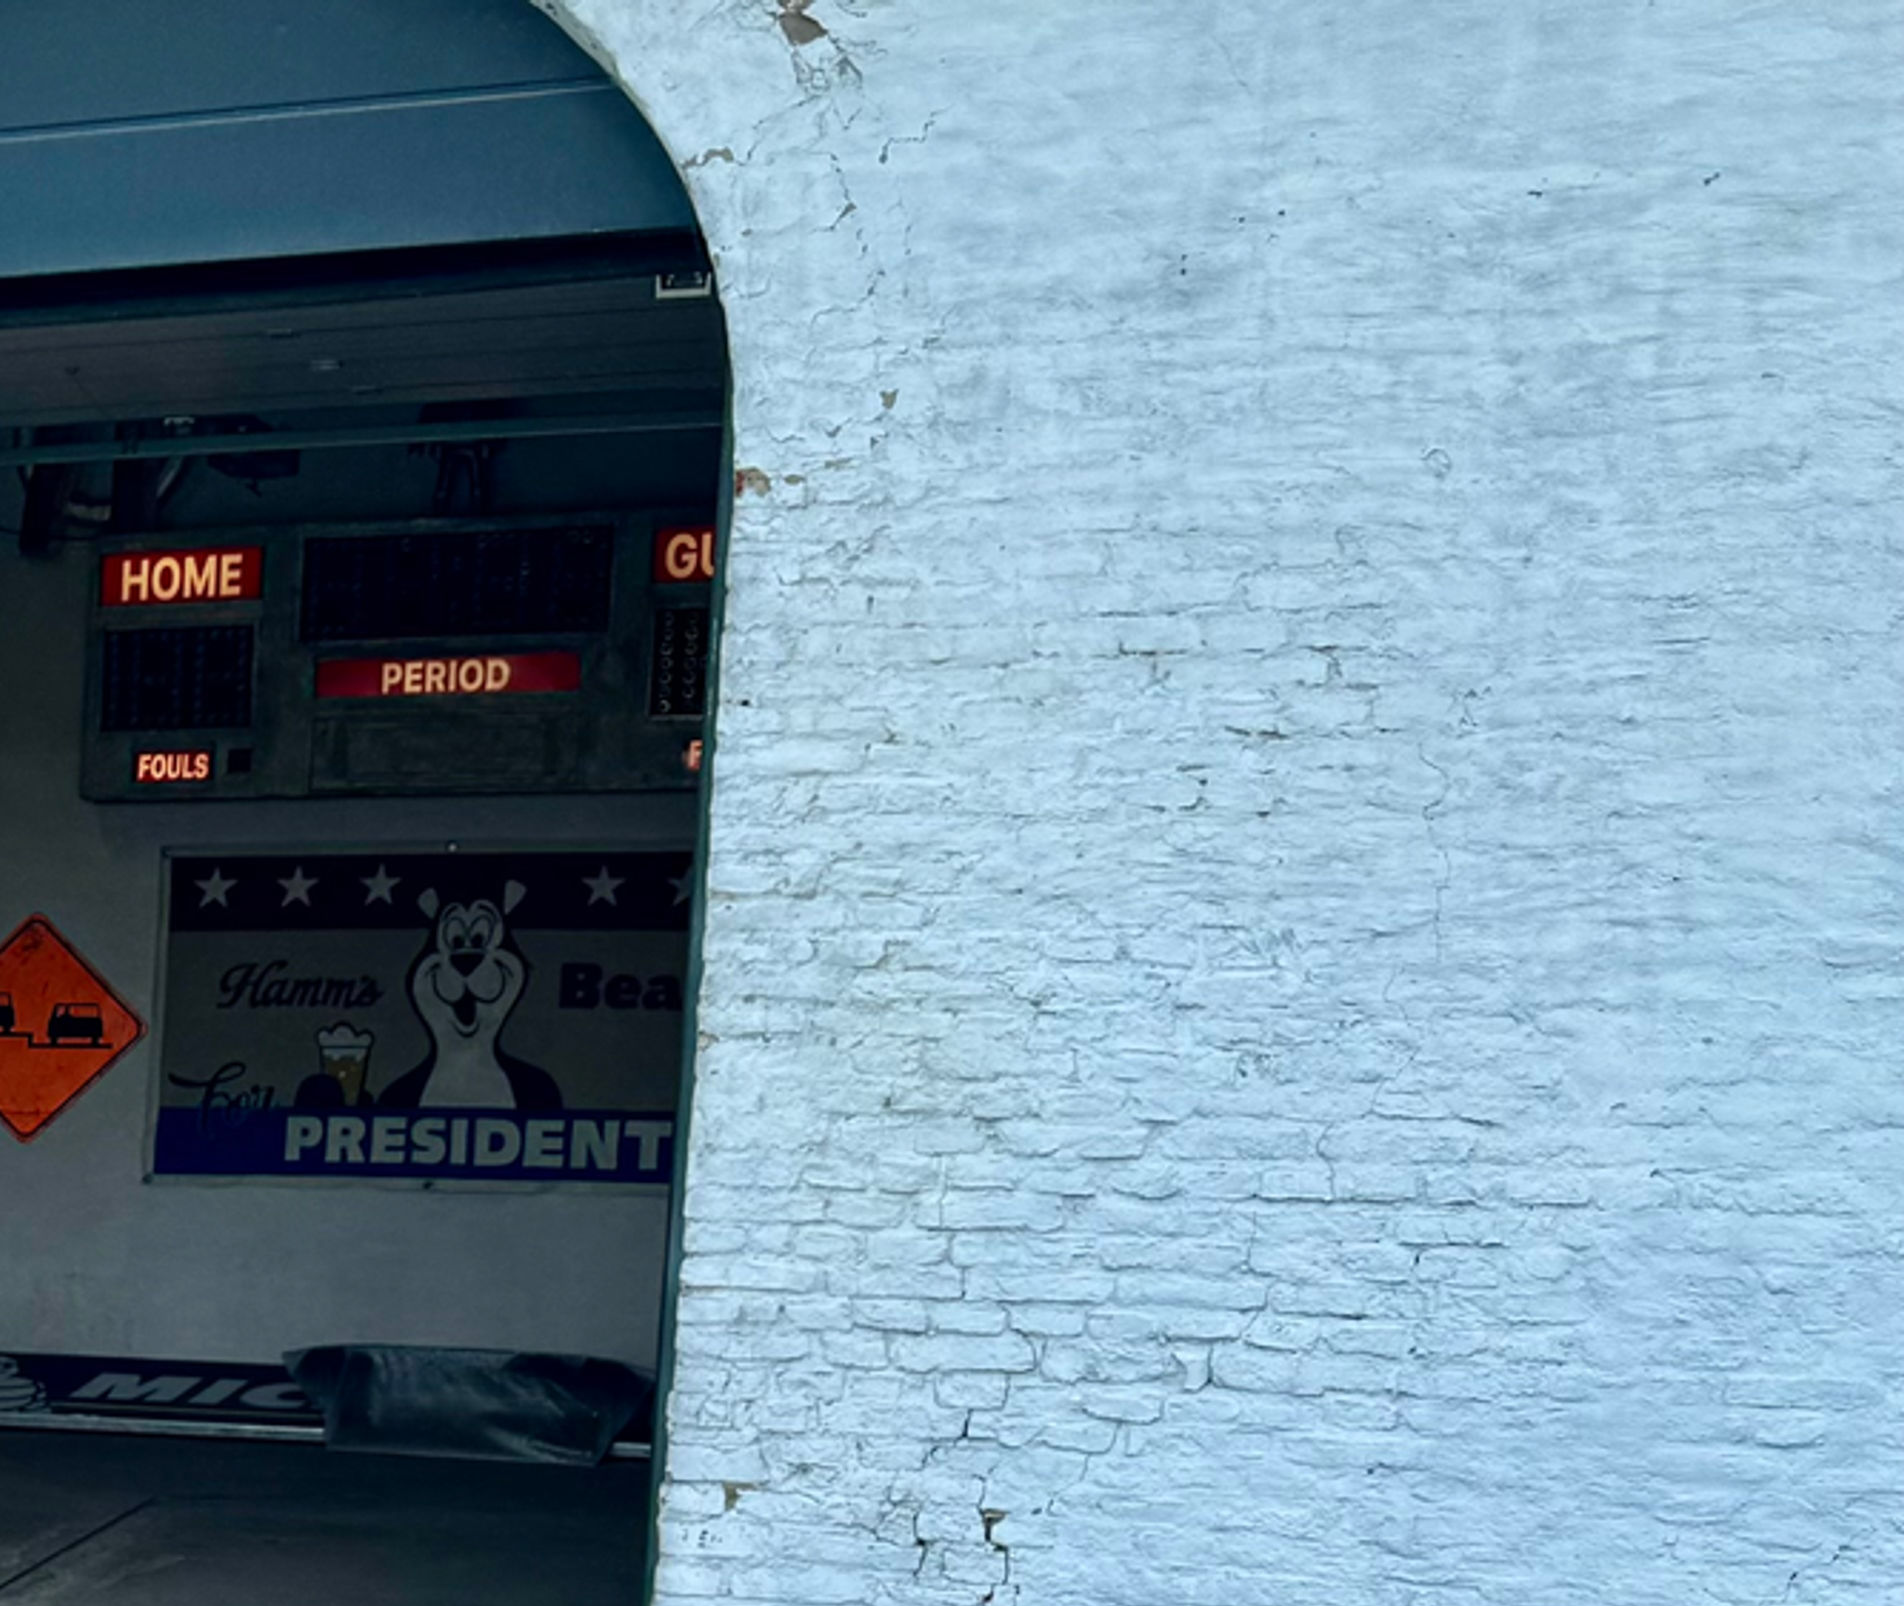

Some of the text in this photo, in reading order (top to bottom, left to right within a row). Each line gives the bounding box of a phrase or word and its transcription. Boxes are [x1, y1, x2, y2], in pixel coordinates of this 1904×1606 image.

[121, 553, 243, 602] HOME
[381, 658, 511, 695] PERIOD
[136, 752, 209, 781] FOULS
[217, 960, 383, 1009] Hamm's
[283, 1115, 674, 1172] PRESIDENT
